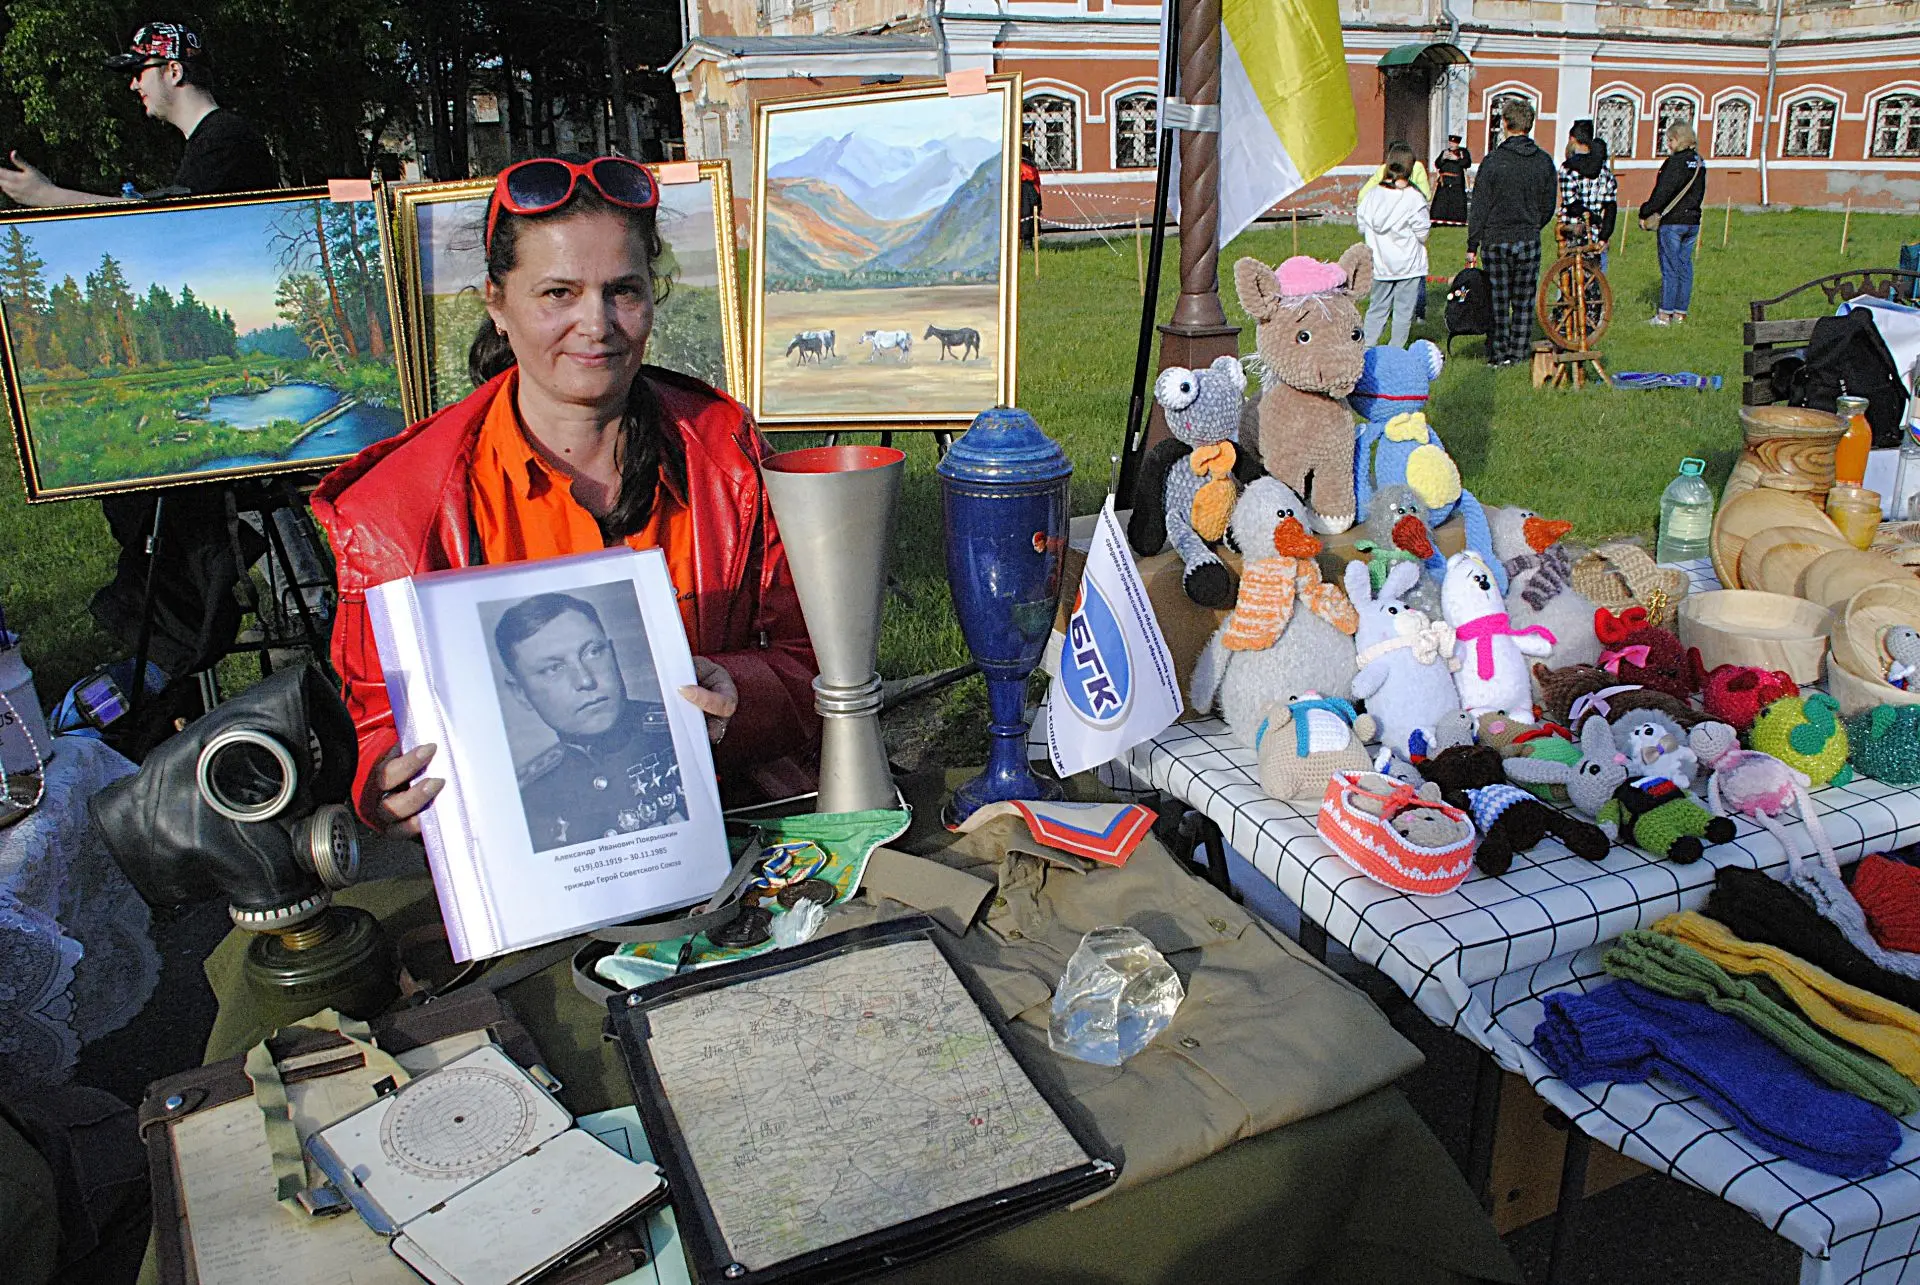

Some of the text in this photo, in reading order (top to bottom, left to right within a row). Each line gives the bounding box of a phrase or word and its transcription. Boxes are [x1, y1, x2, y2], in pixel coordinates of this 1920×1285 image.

[1105, 538, 1166, 687] среднего профессионального образования
[1118, 550, 1147, 613] государственное
[1144, 613, 1169, 675] образовательное
[1071, 614, 1118, 713] БГК
[554, 831, 678, 862] Александр Иванович Покрышкин
[564, 859, 682, 892] трижды Герой Советского Союза
[630, 847, 668, 860] 30.11.1985
